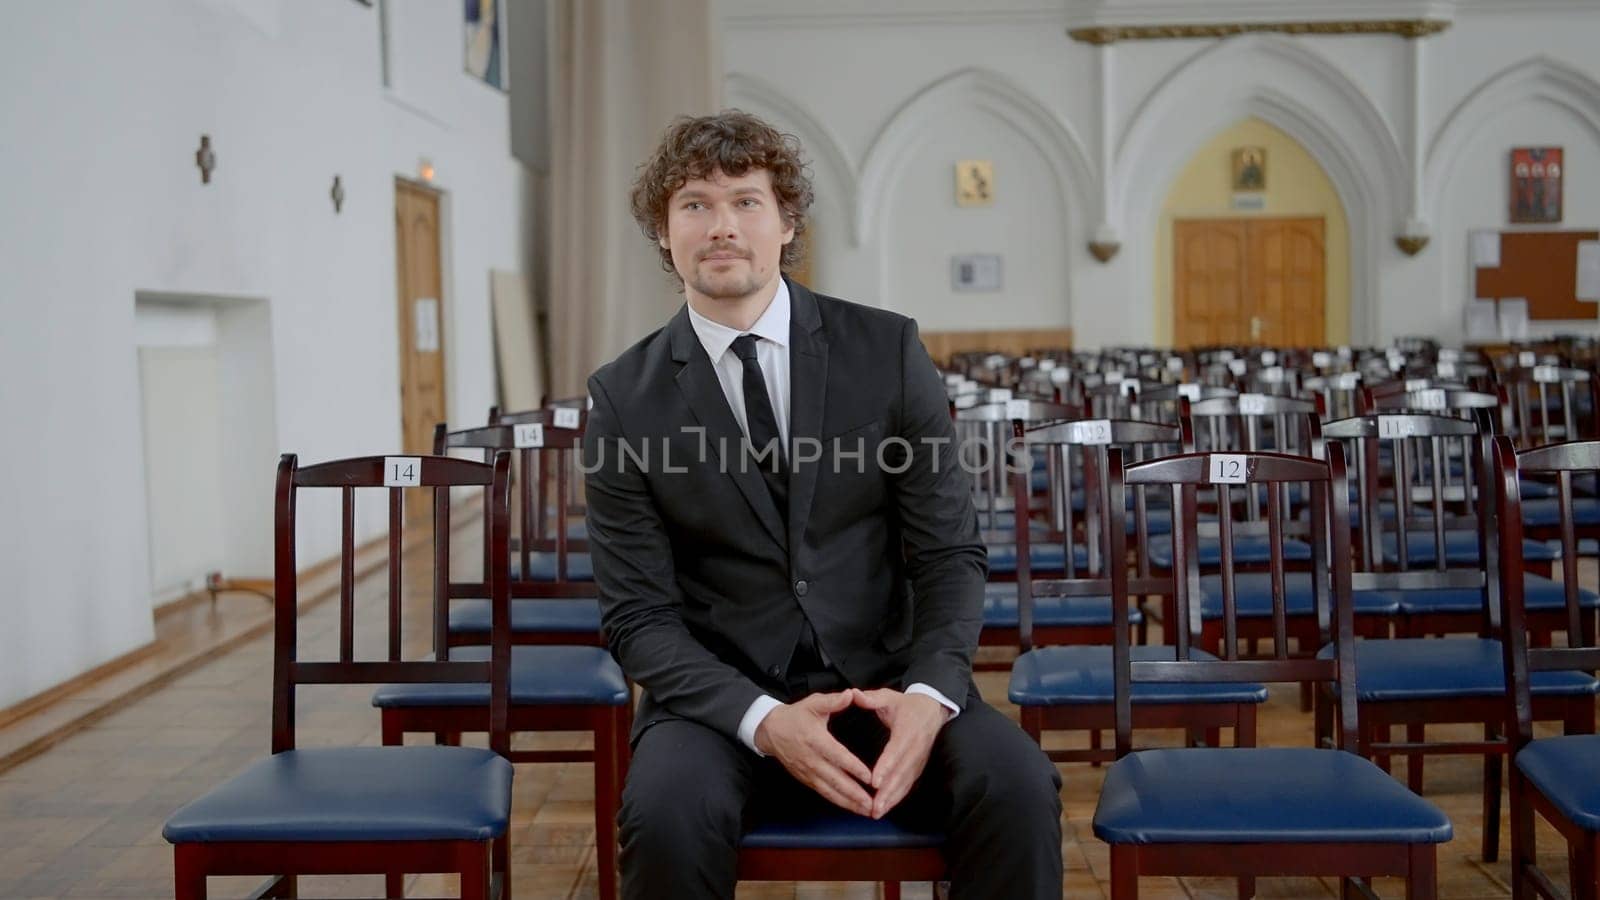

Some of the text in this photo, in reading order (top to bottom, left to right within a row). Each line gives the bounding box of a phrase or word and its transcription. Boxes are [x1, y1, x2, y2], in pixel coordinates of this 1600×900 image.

[520, 428, 538, 443] 14
[392, 463, 415, 482] 14
[1217, 460, 1240, 479] 12
